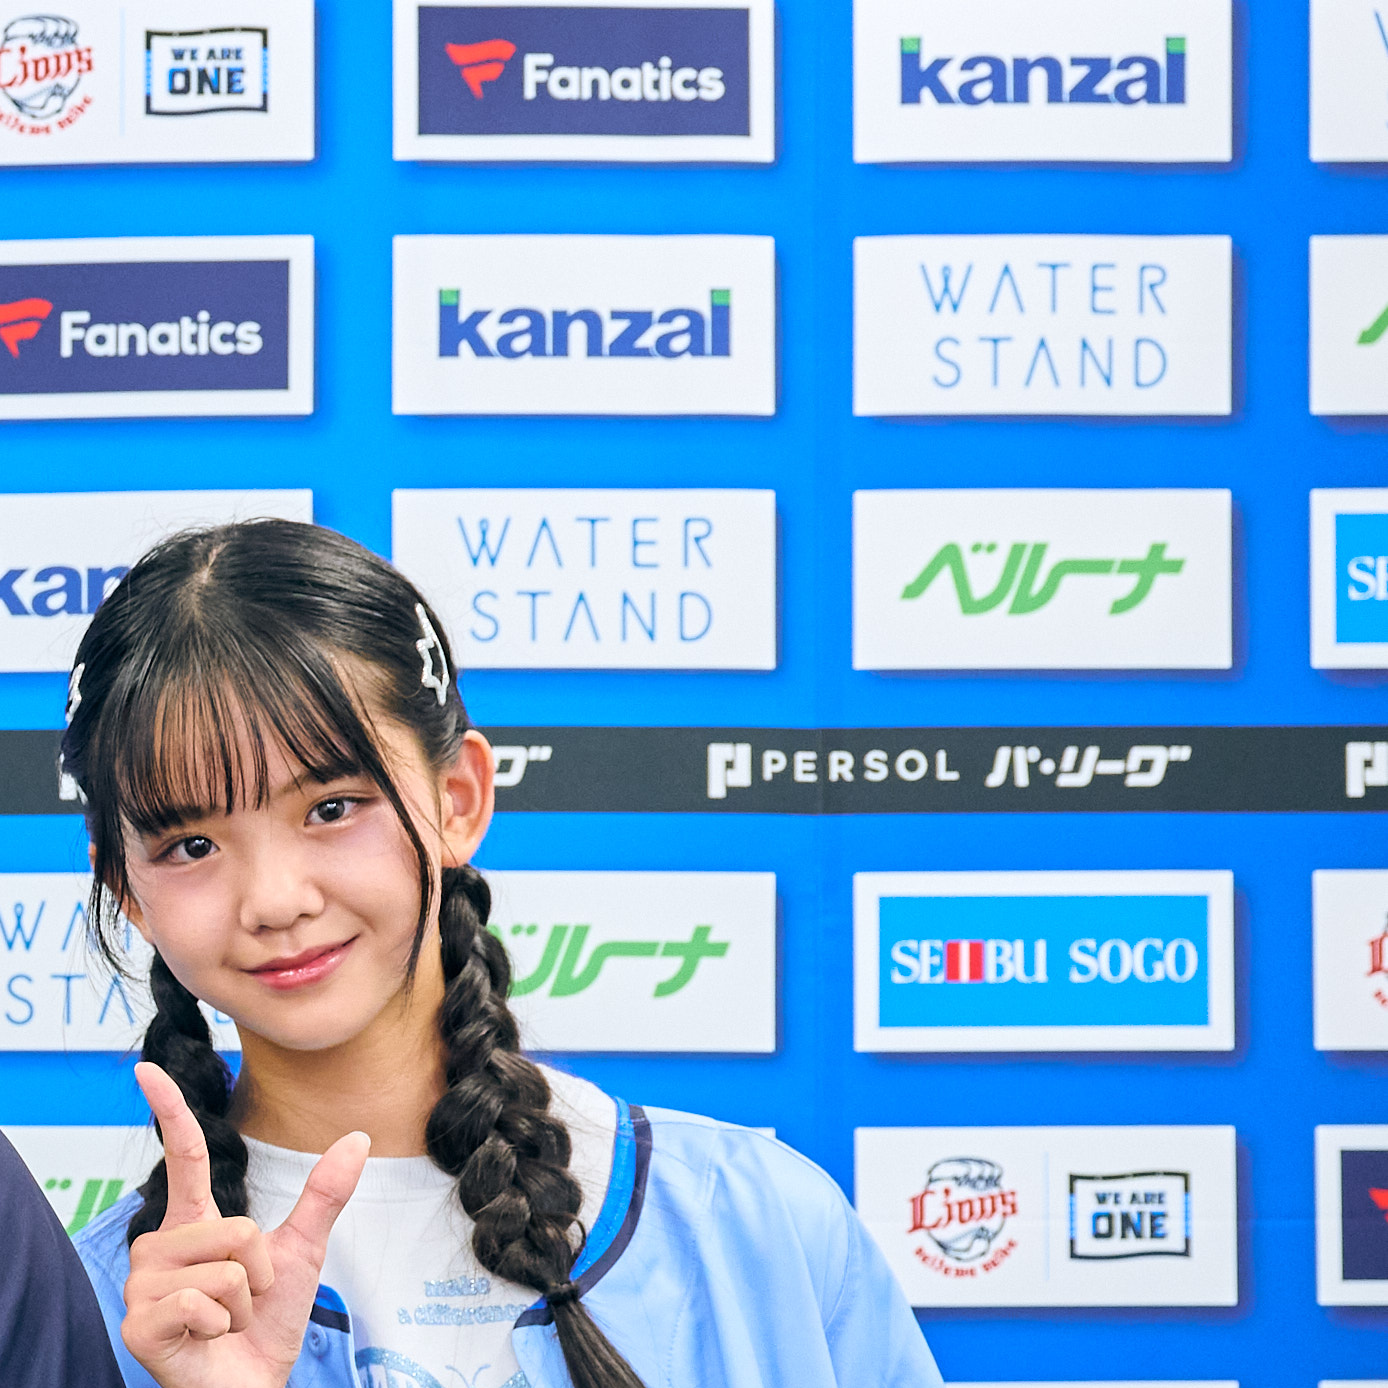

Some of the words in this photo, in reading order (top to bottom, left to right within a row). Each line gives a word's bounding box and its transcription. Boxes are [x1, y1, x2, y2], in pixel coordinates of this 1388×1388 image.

[172, 49, 197, 61] WE
[206, 48, 242, 60] ARE
[524, 54, 725, 101] Fanatics
[900, 37, 1186, 106] kanzai
[168, 67, 245, 95] ONE
[920, 262, 1168, 315] WATER
[61, 310, 262, 357] Fanatics
[438, 289, 731, 360] kanzai
[933, 336, 1168, 389] STAND
[457, 517, 713, 569] WATER
[901, 542, 1186, 615] ベルーナ
[470, 590, 713, 643] STAND
[763, 749, 959, 782] PERSOL
[892, 939, 1047, 983] SEIBU
[1069, 938, 1198, 983] SOGO
[5, 975, 136, 1024] STA
[907, 1180, 1019, 1233] Lions
[1095, 1193, 1120, 1205] WE
[1130, 1192, 1164, 1205] ARE
[1092, 1211, 1167, 1239] ONE
